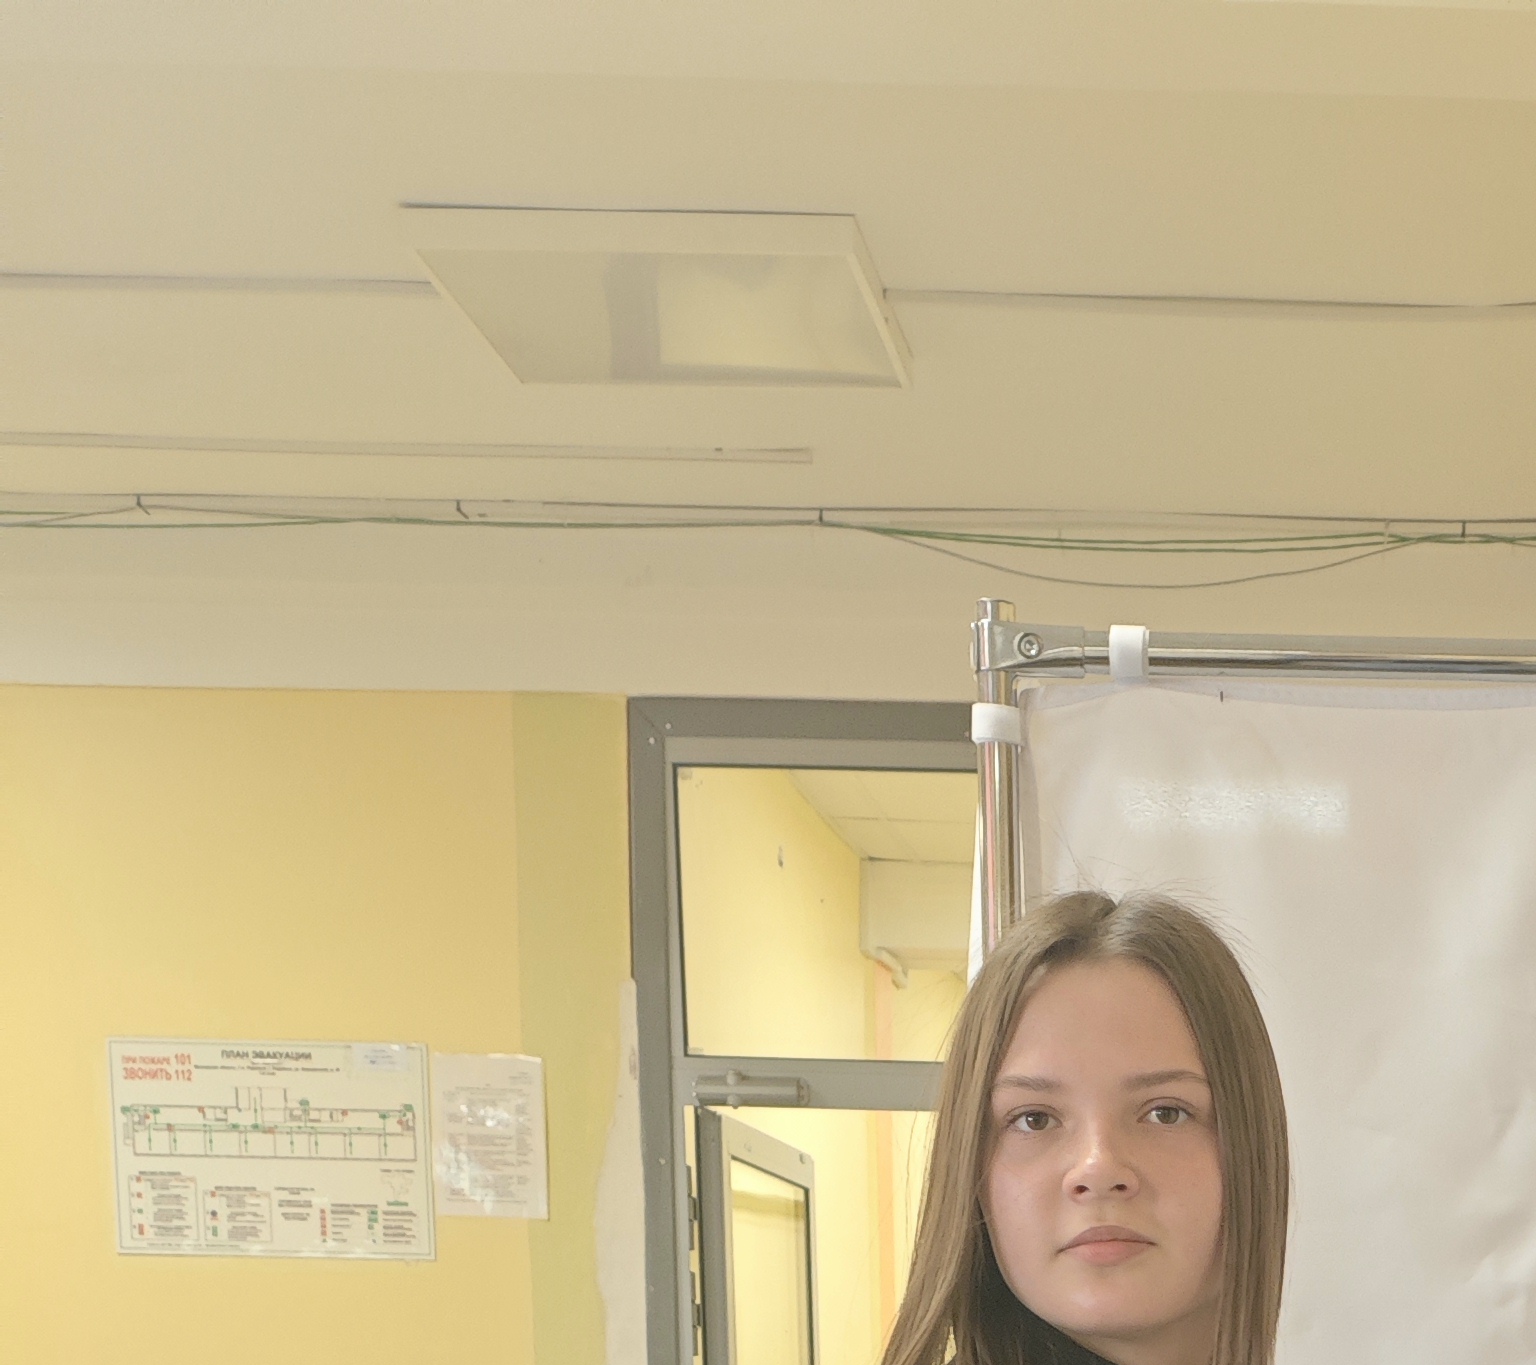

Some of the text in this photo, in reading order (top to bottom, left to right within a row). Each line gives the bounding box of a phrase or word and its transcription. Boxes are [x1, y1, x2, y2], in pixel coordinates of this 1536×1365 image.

[174, 1053, 192, 1066] 101
[122, 1066, 172, 1081] ЗВОНИТЬ
[174, 1068, 193, 1082] 112
